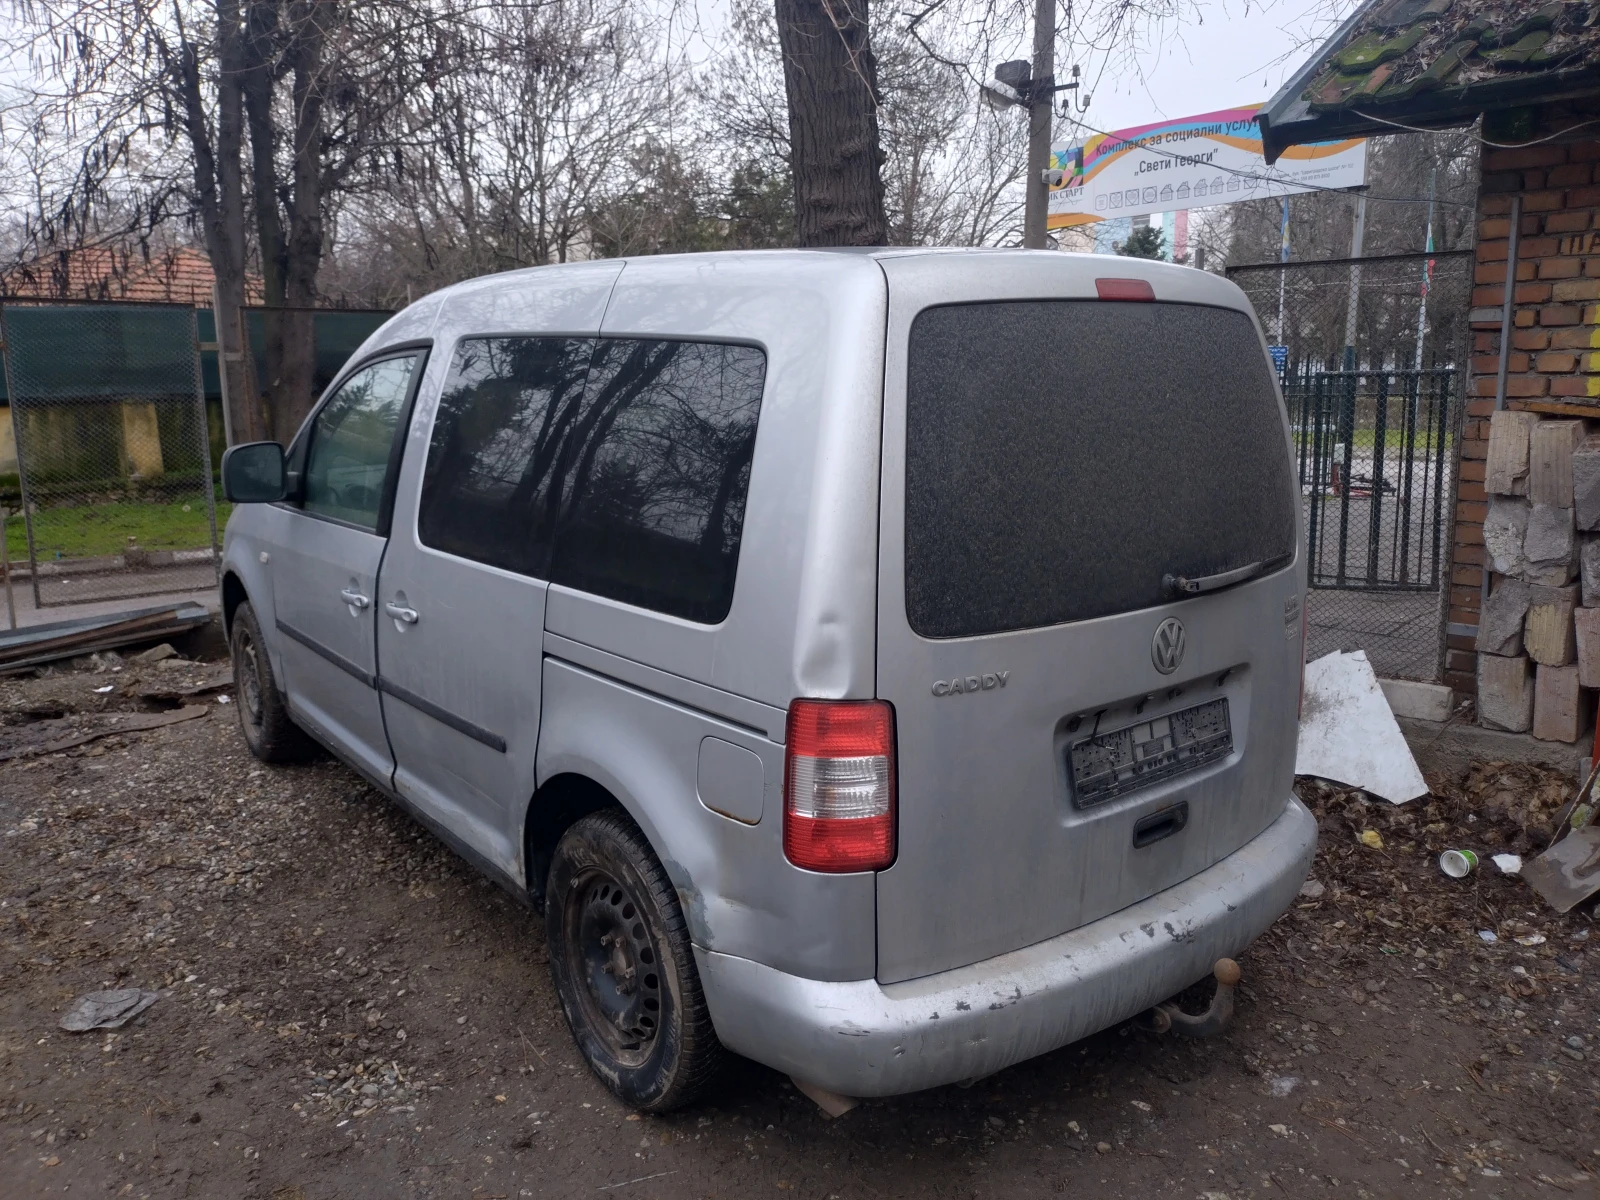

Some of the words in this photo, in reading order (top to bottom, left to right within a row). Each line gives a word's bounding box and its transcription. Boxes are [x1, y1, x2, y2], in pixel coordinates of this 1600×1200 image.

[1096, 138, 1147, 156] Комплекс
[1150, 135, 1162, 146] за
[1165, 123, 1222, 143] социални
[1059, 187, 1084, 199] СТАРТ
[931, 670, 1010, 697] CADDY
